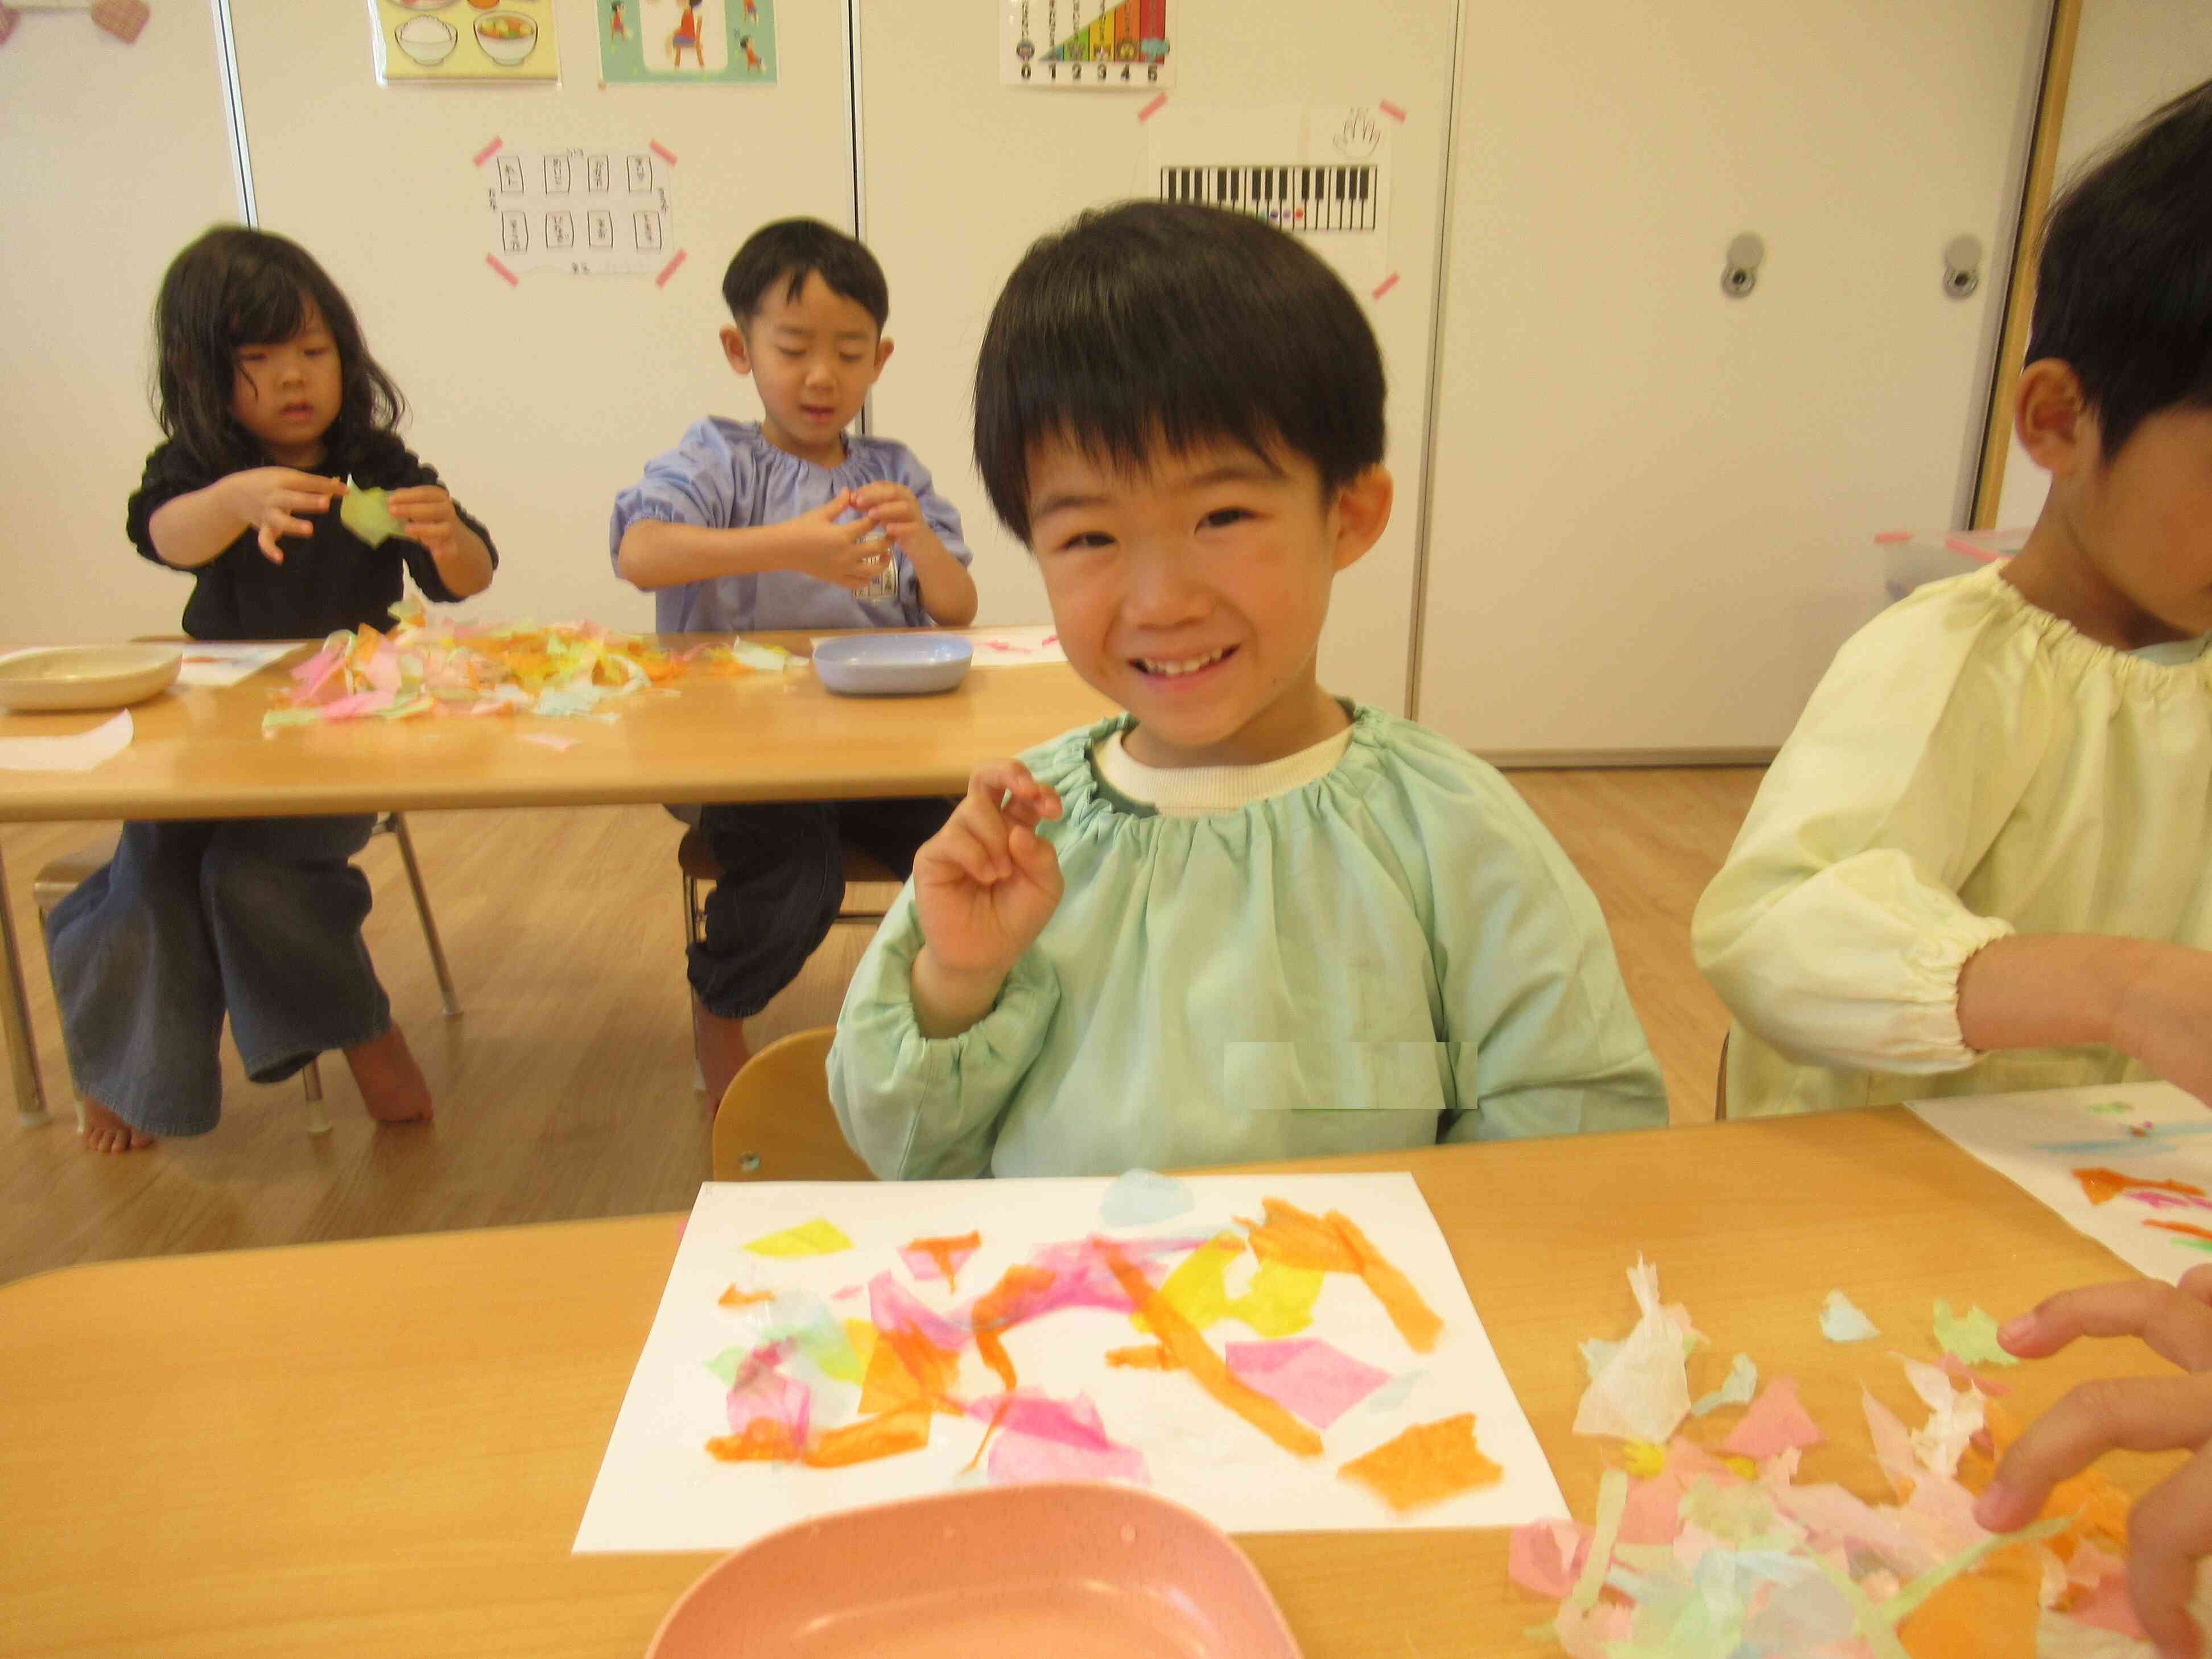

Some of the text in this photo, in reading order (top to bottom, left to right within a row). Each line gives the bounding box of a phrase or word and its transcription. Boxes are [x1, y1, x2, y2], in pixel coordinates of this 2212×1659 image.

[1021, 63, 1157, 81] 0 1 2 3 4 5
